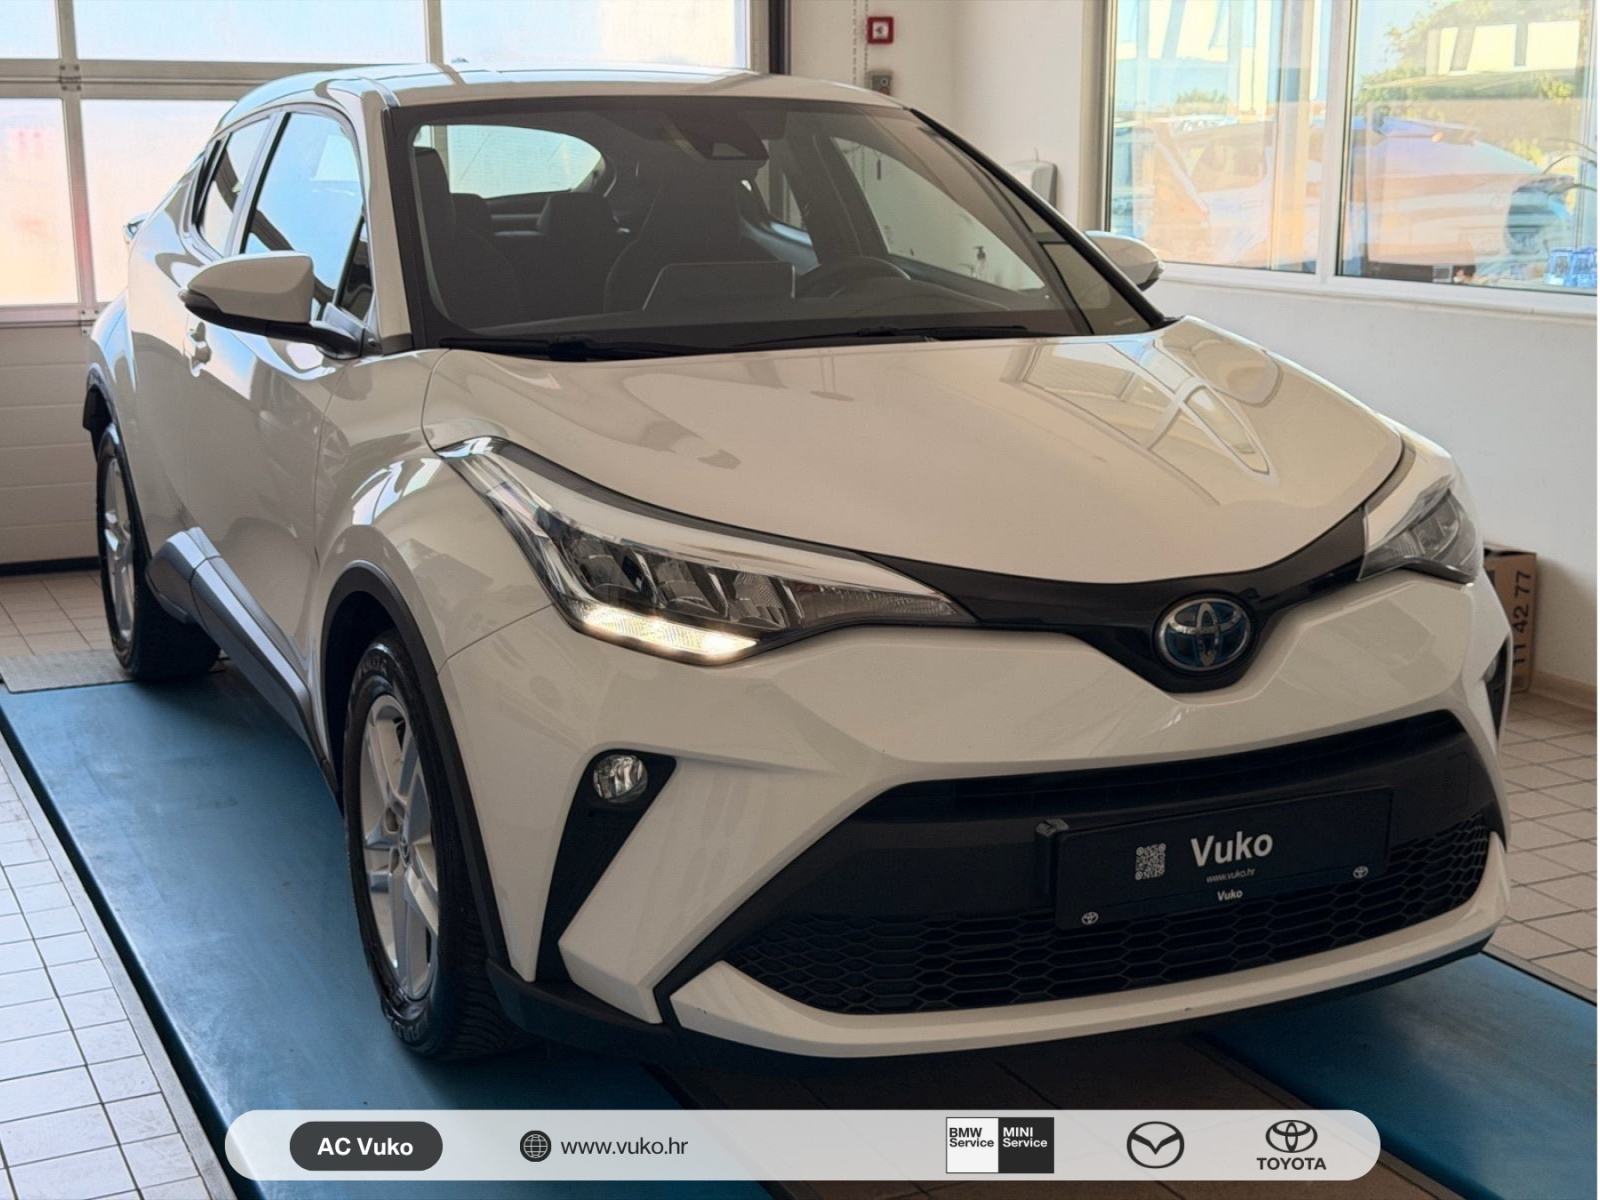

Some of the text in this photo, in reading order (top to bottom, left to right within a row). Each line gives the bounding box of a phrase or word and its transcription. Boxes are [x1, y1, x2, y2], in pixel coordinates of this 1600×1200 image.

[1514, 570, 1531, 598] 77
[1512, 604, 1529, 634] 42
[1190, 831, 1273, 867] Vuko
[1205, 867, 1256, 884] www.vuko.hr
[1216, 888, 1244, 902] Vuko
